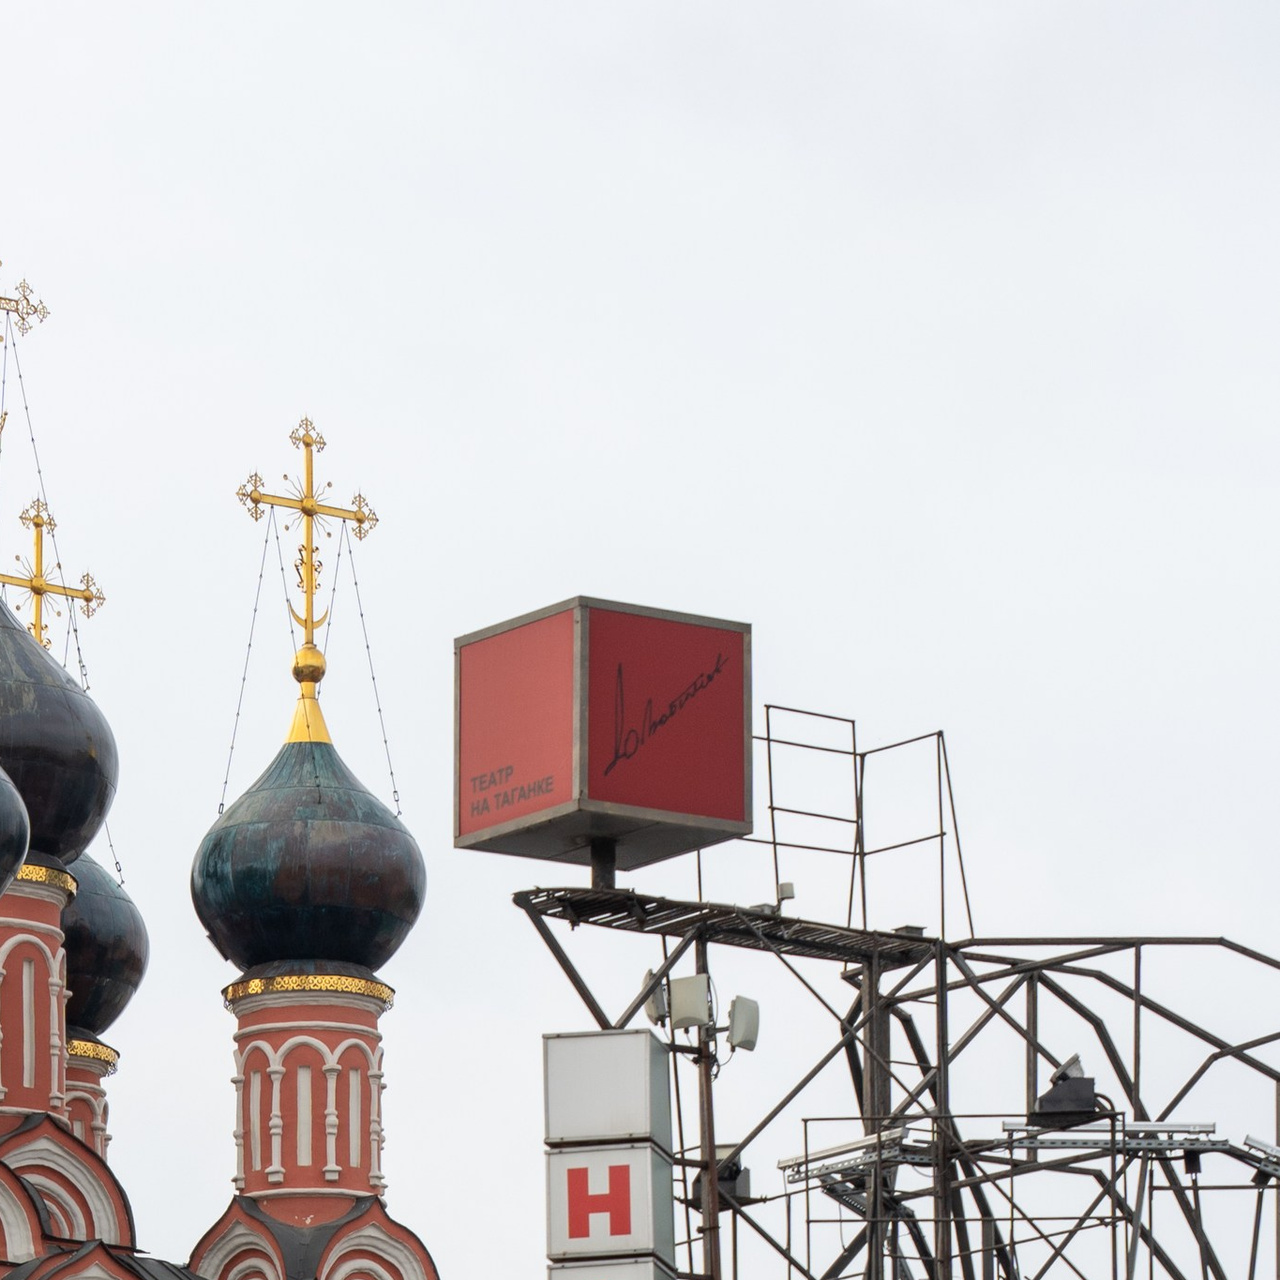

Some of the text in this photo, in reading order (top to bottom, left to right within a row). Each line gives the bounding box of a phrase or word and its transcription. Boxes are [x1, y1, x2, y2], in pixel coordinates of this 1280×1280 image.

[470, 765, 514, 795] ТЕАТР
[471, 776, 555, 817] НА ТАГАНКЕ
